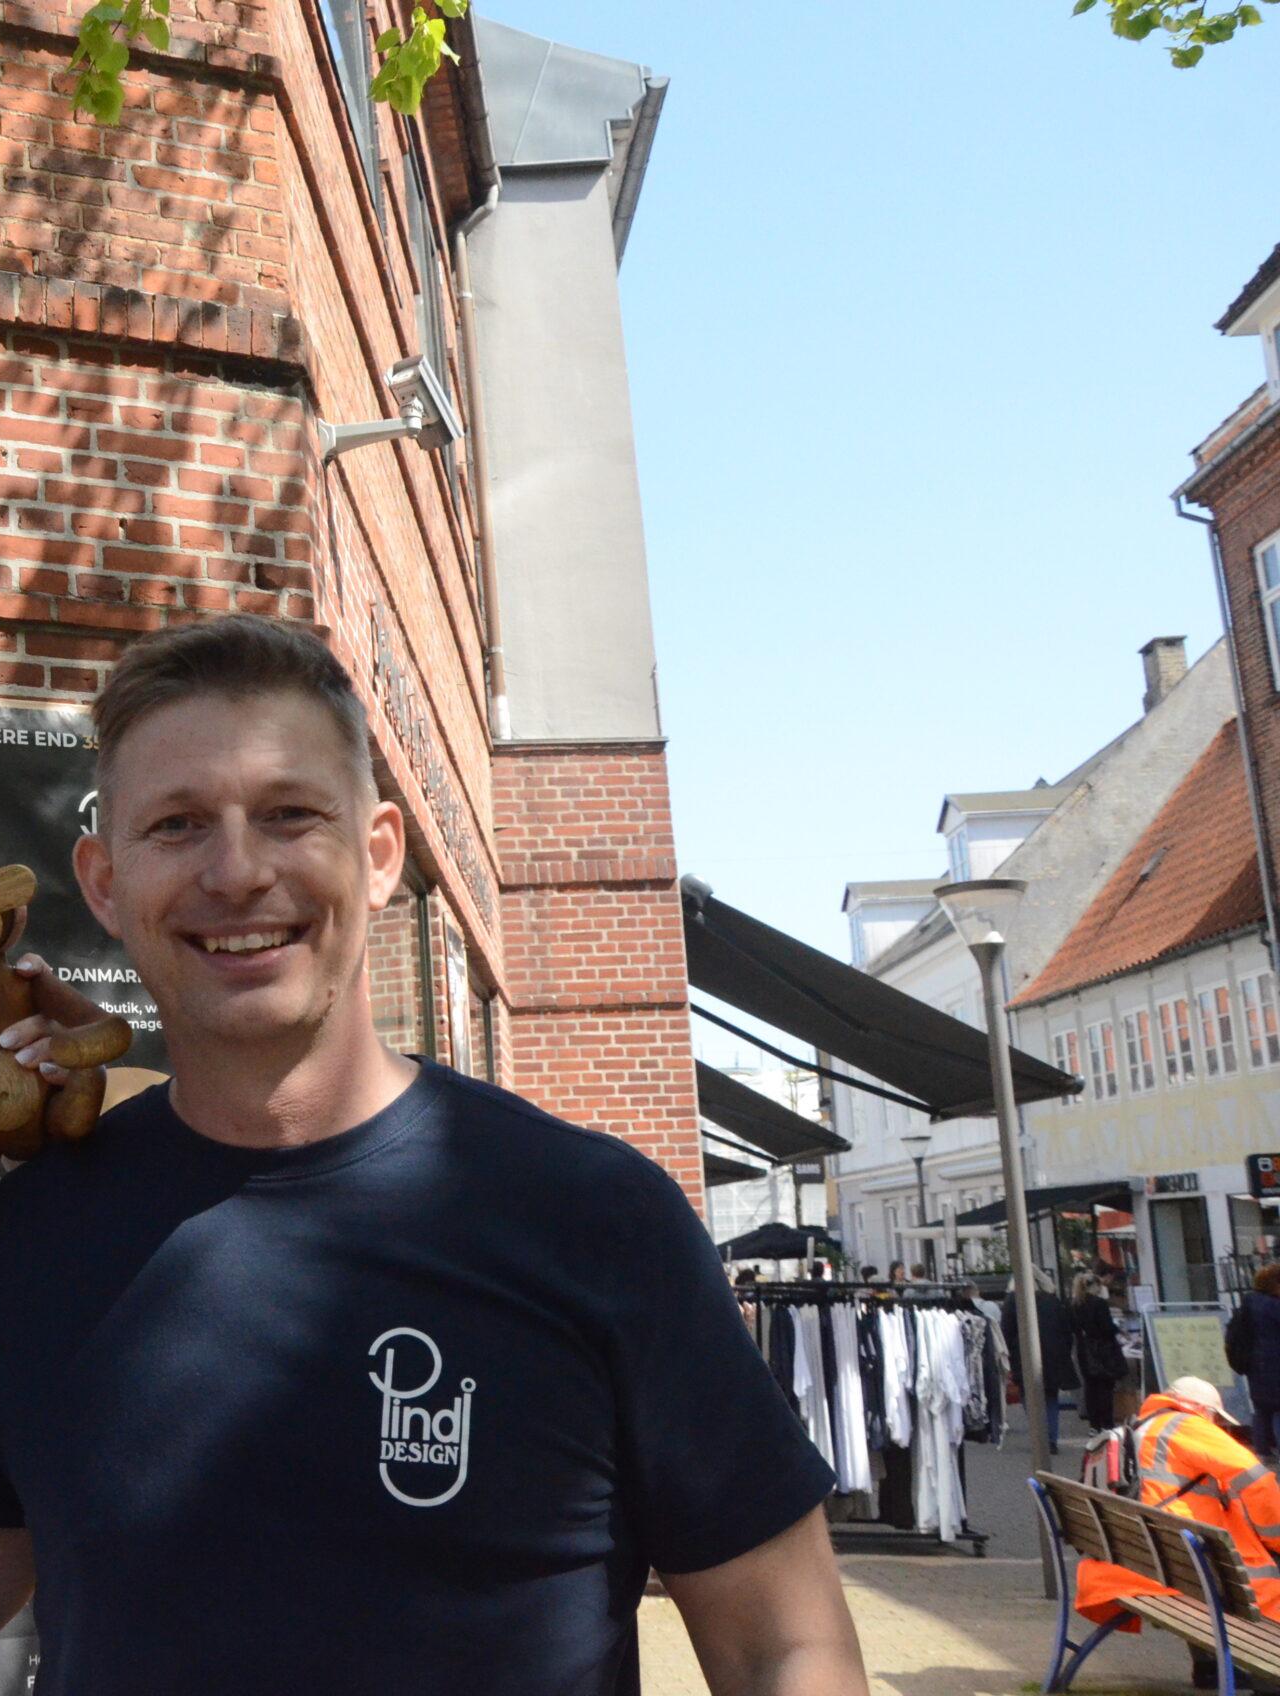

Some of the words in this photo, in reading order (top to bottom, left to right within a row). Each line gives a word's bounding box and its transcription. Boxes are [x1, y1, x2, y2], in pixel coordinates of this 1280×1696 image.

[34, 730, 78, 748] END
[58, 967, 142, 983] DANMAR
[379, 1440, 459, 1466] DESIGN
